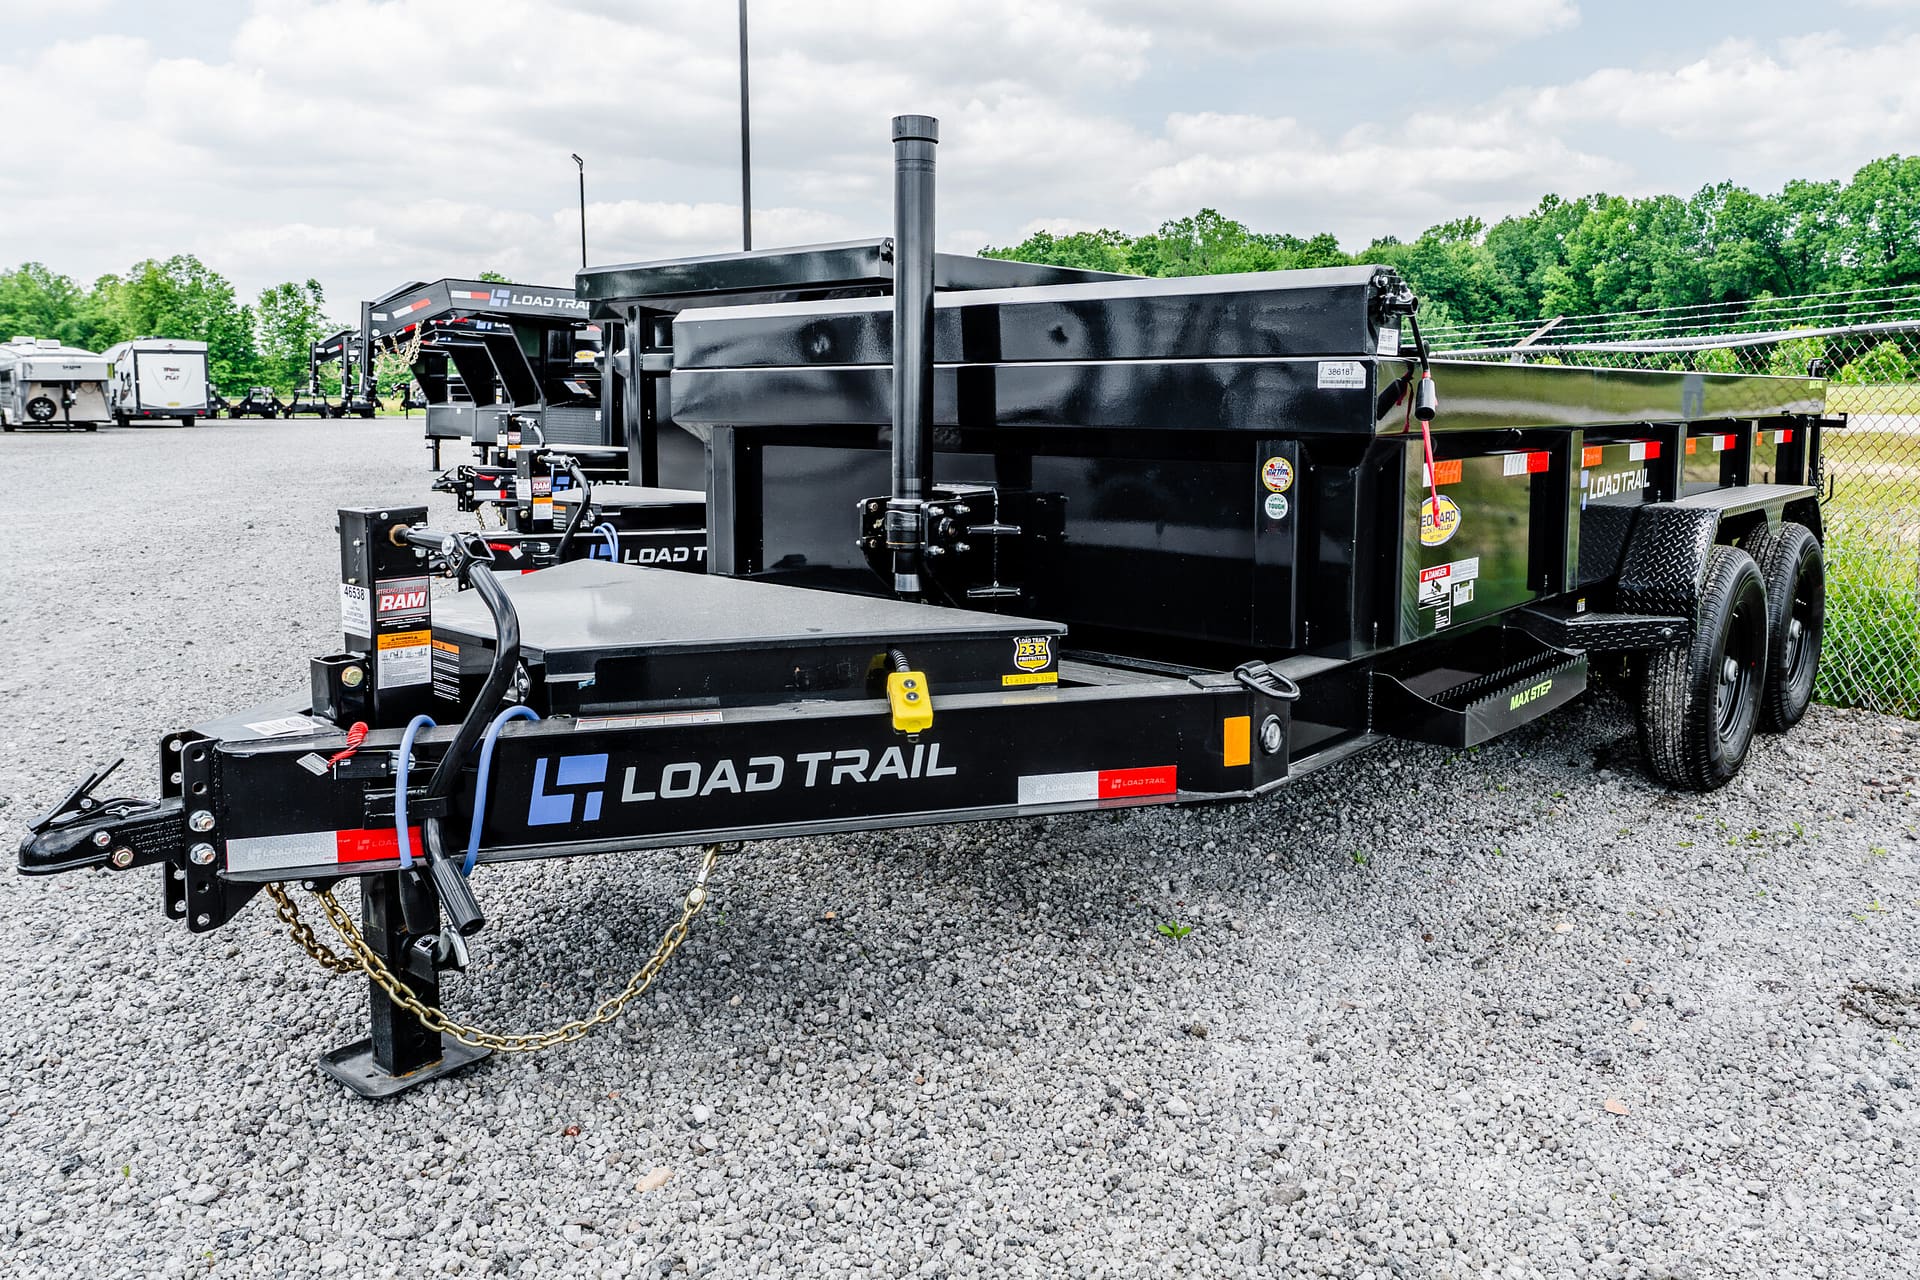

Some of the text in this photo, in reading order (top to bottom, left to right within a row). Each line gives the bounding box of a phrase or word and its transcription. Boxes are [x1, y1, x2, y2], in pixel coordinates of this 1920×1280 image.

[512, 294, 589, 310] LOAD TRAI
[1328, 368, 1354, 376] 386187
[533, 482, 550, 490] RAM
[1589, 468, 1650, 499] LOAD TRAIL
[1421, 510, 1456, 528] EOARD
[624, 547, 689, 563] LOAD
[344, 585, 365, 601] 46538
[380, 592, 427, 611] RAM
[1021, 644, 1044, 656] 232
[1509, 679, 1552, 711] MAX STEP
[621, 743, 957, 803] LOAD TRAIL
[1122, 777, 1167, 787] LOAD TRAIL
